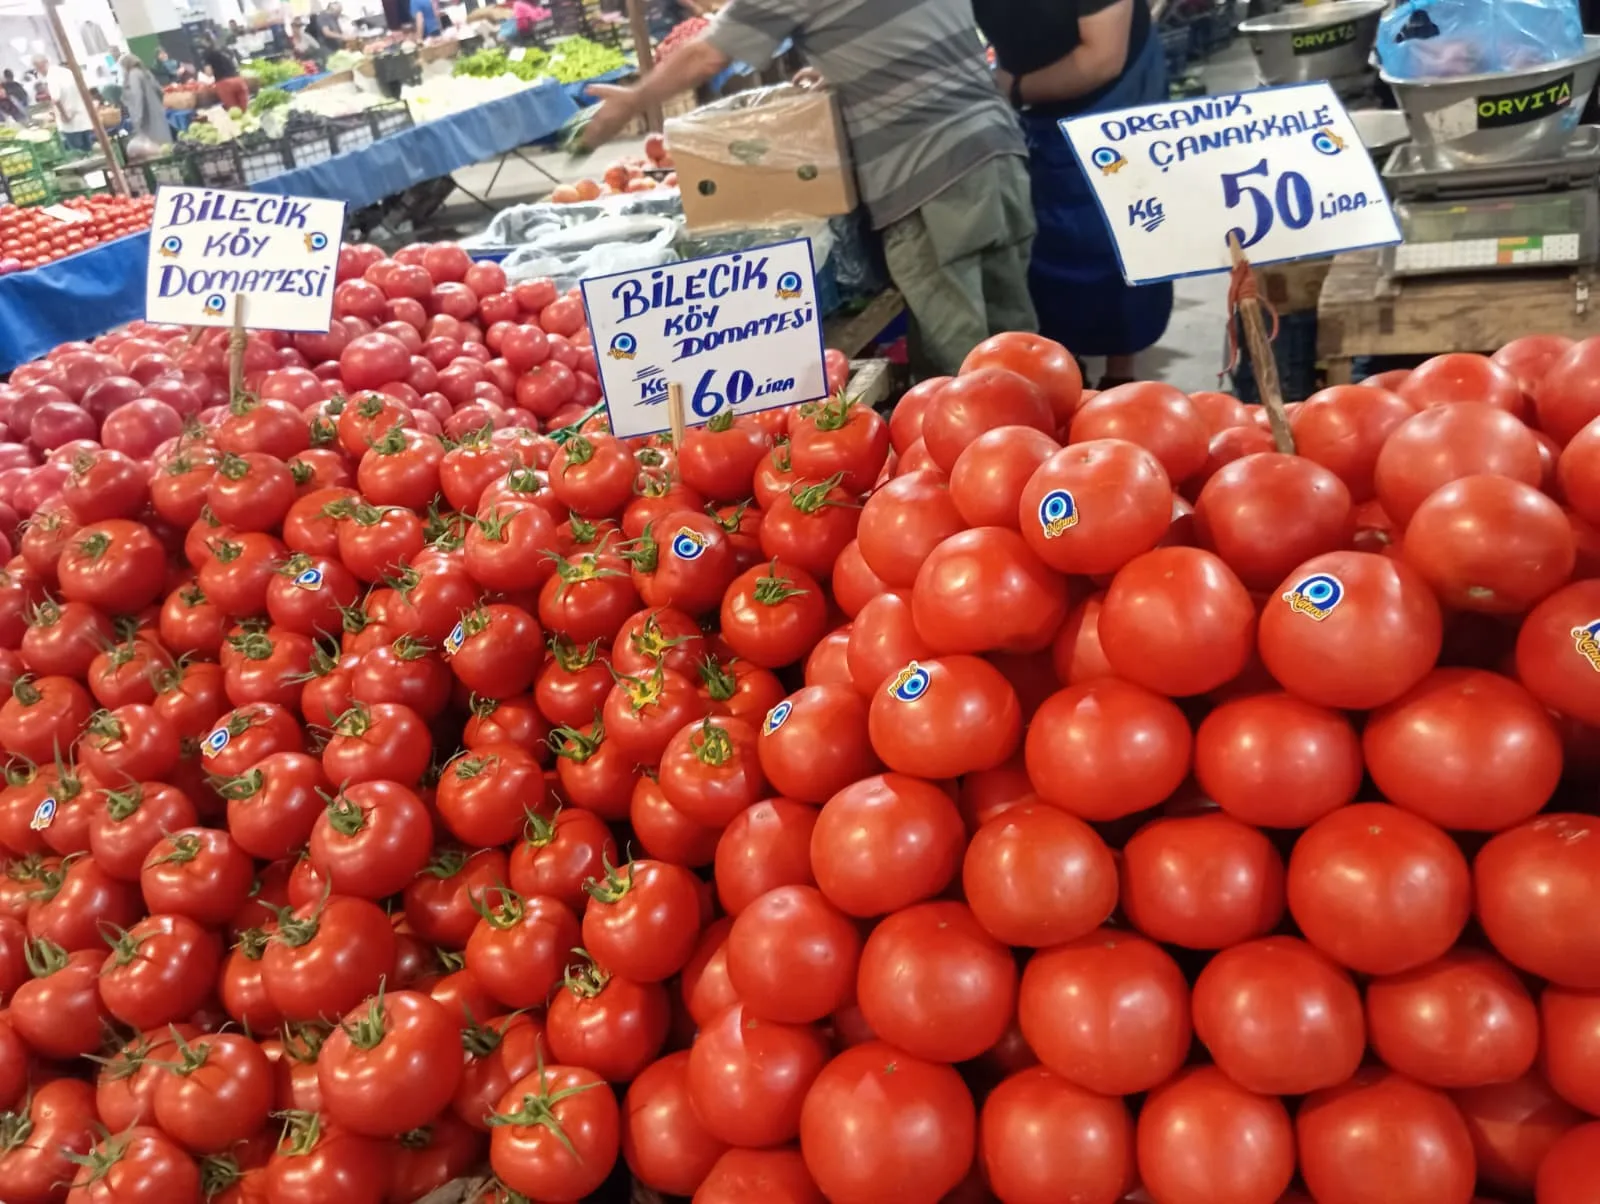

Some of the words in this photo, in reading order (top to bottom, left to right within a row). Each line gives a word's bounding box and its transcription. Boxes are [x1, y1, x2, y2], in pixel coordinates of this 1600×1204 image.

[1293, 24, 1355, 48] ORVITA
[1101, 95, 1252, 141] ORGANİK
[1479, 82, 1570, 117] ORVITA
[1149, 105, 1334, 172] ÇANAKKALE
[160, 191, 311, 229] BİLECİK
[1128, 197, 1163, 226] KG
[1221, 158, 1314, 250] 50
[203, 227, 270, 258] KÖY
[157, 265, 330, 298] DOMATESİ
[612, 254, 768, 324] BİLECİK
[664, 305, 720, 336] KÖY
[672, 302, 812, 362] DOMATESİ
[641, 378, 669, 399] KG
[691, 369, 753, 417] 60
[755, 378, 794, 397] LİRA
